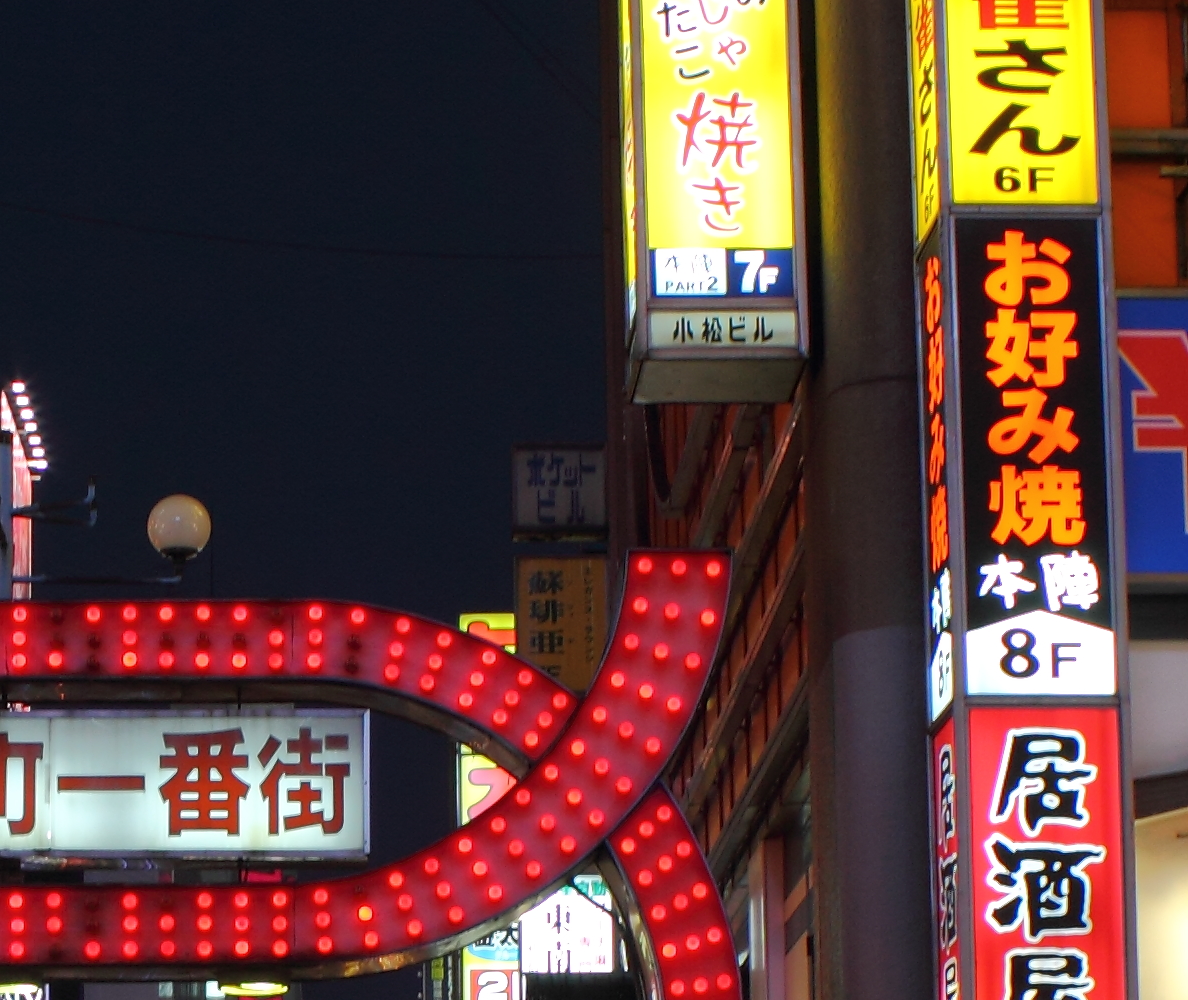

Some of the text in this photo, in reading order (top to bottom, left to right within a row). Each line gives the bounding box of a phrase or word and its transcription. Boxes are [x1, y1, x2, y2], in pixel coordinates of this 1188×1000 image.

[994, 167, 1055, 193] 6F
[734, 250, 779, 293] 7F
[672, 317, 774, 344] 小松ビル
[985, 230, 1087, 546] お好み焼
[998, 627, 1083, 679] 8F
